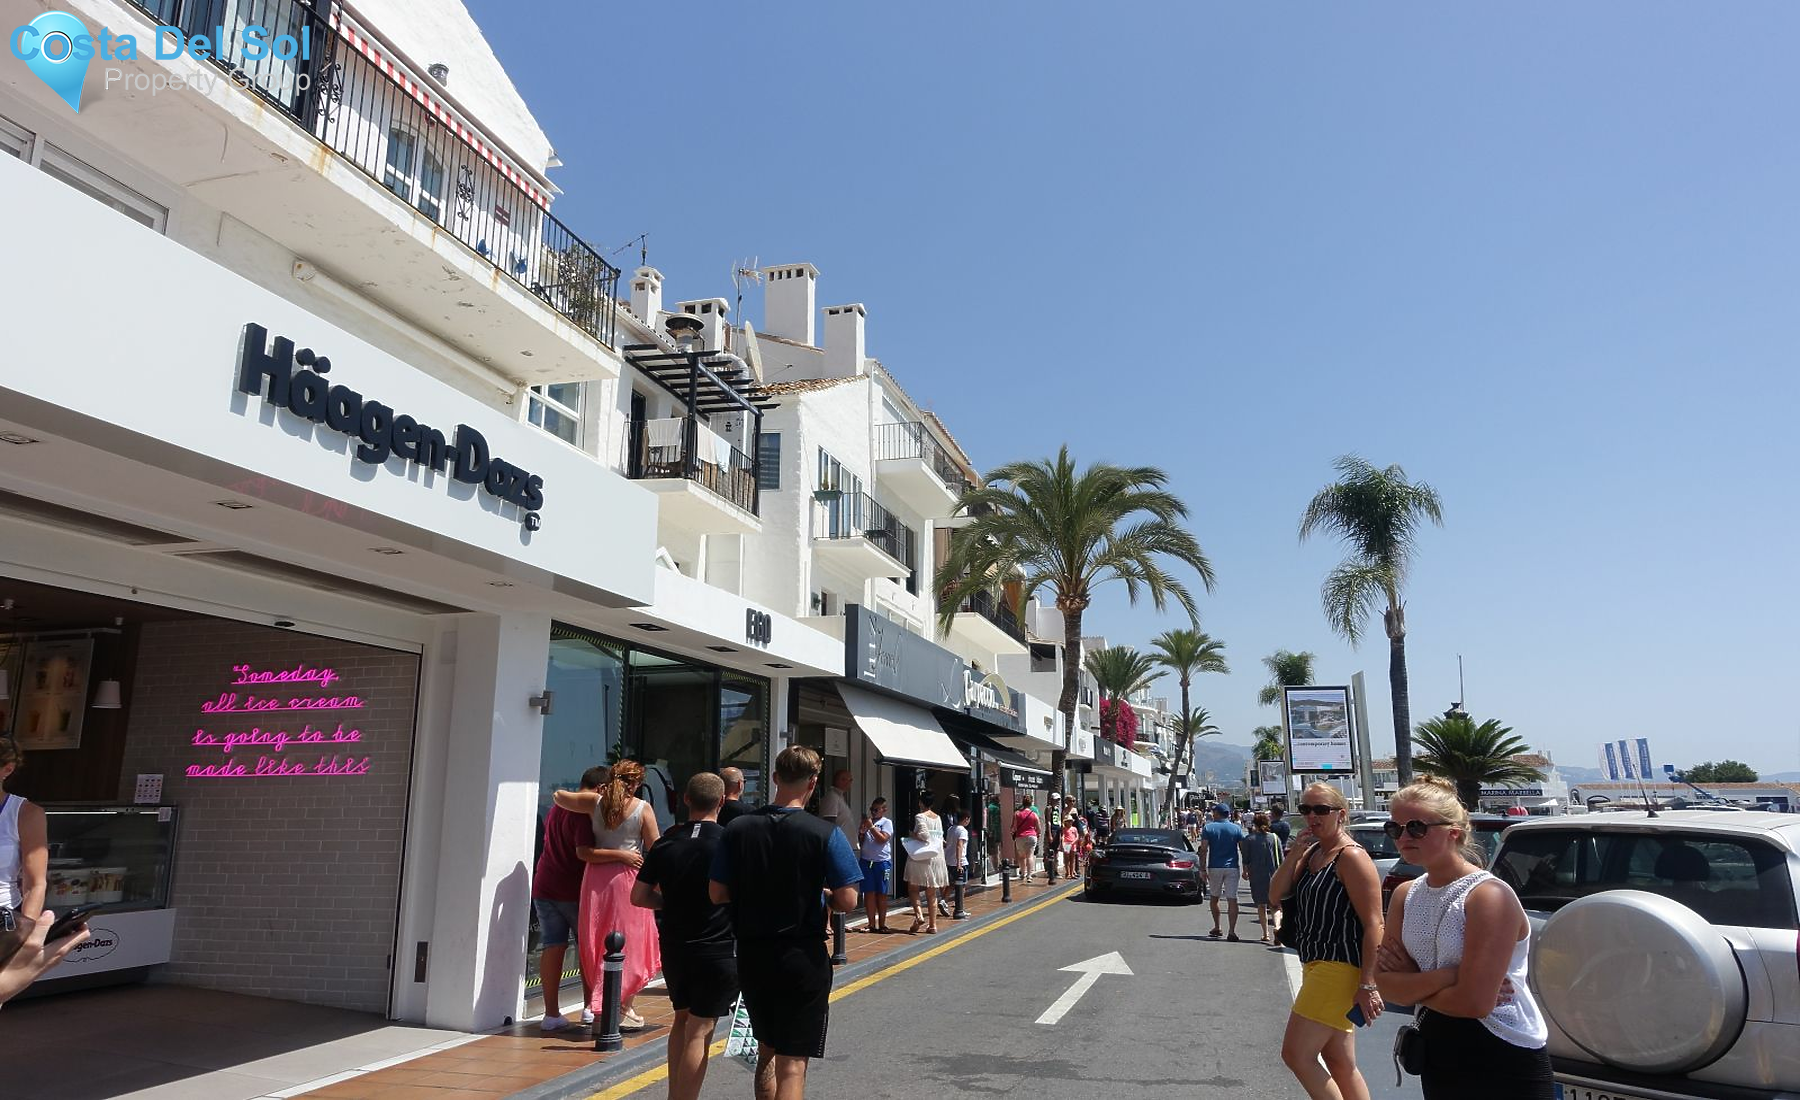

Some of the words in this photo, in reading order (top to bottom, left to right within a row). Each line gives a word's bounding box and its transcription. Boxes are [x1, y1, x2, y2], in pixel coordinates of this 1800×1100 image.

[240, 322, 544, 511] Häagen-Dazs
[201, 692, 237, 712] all
[244, 695, 280, 711] ice
[288, 695, 365, 710] cream
[192, 728, 218, 745] is
[224, 727, 291, 753] going
[298, 724, 324, 743] to
[333, 723, 361, 743] be
[186, 758, 248, 777] made
[255, 755, 306, 776] like
[314, 754, 371, 775] this
